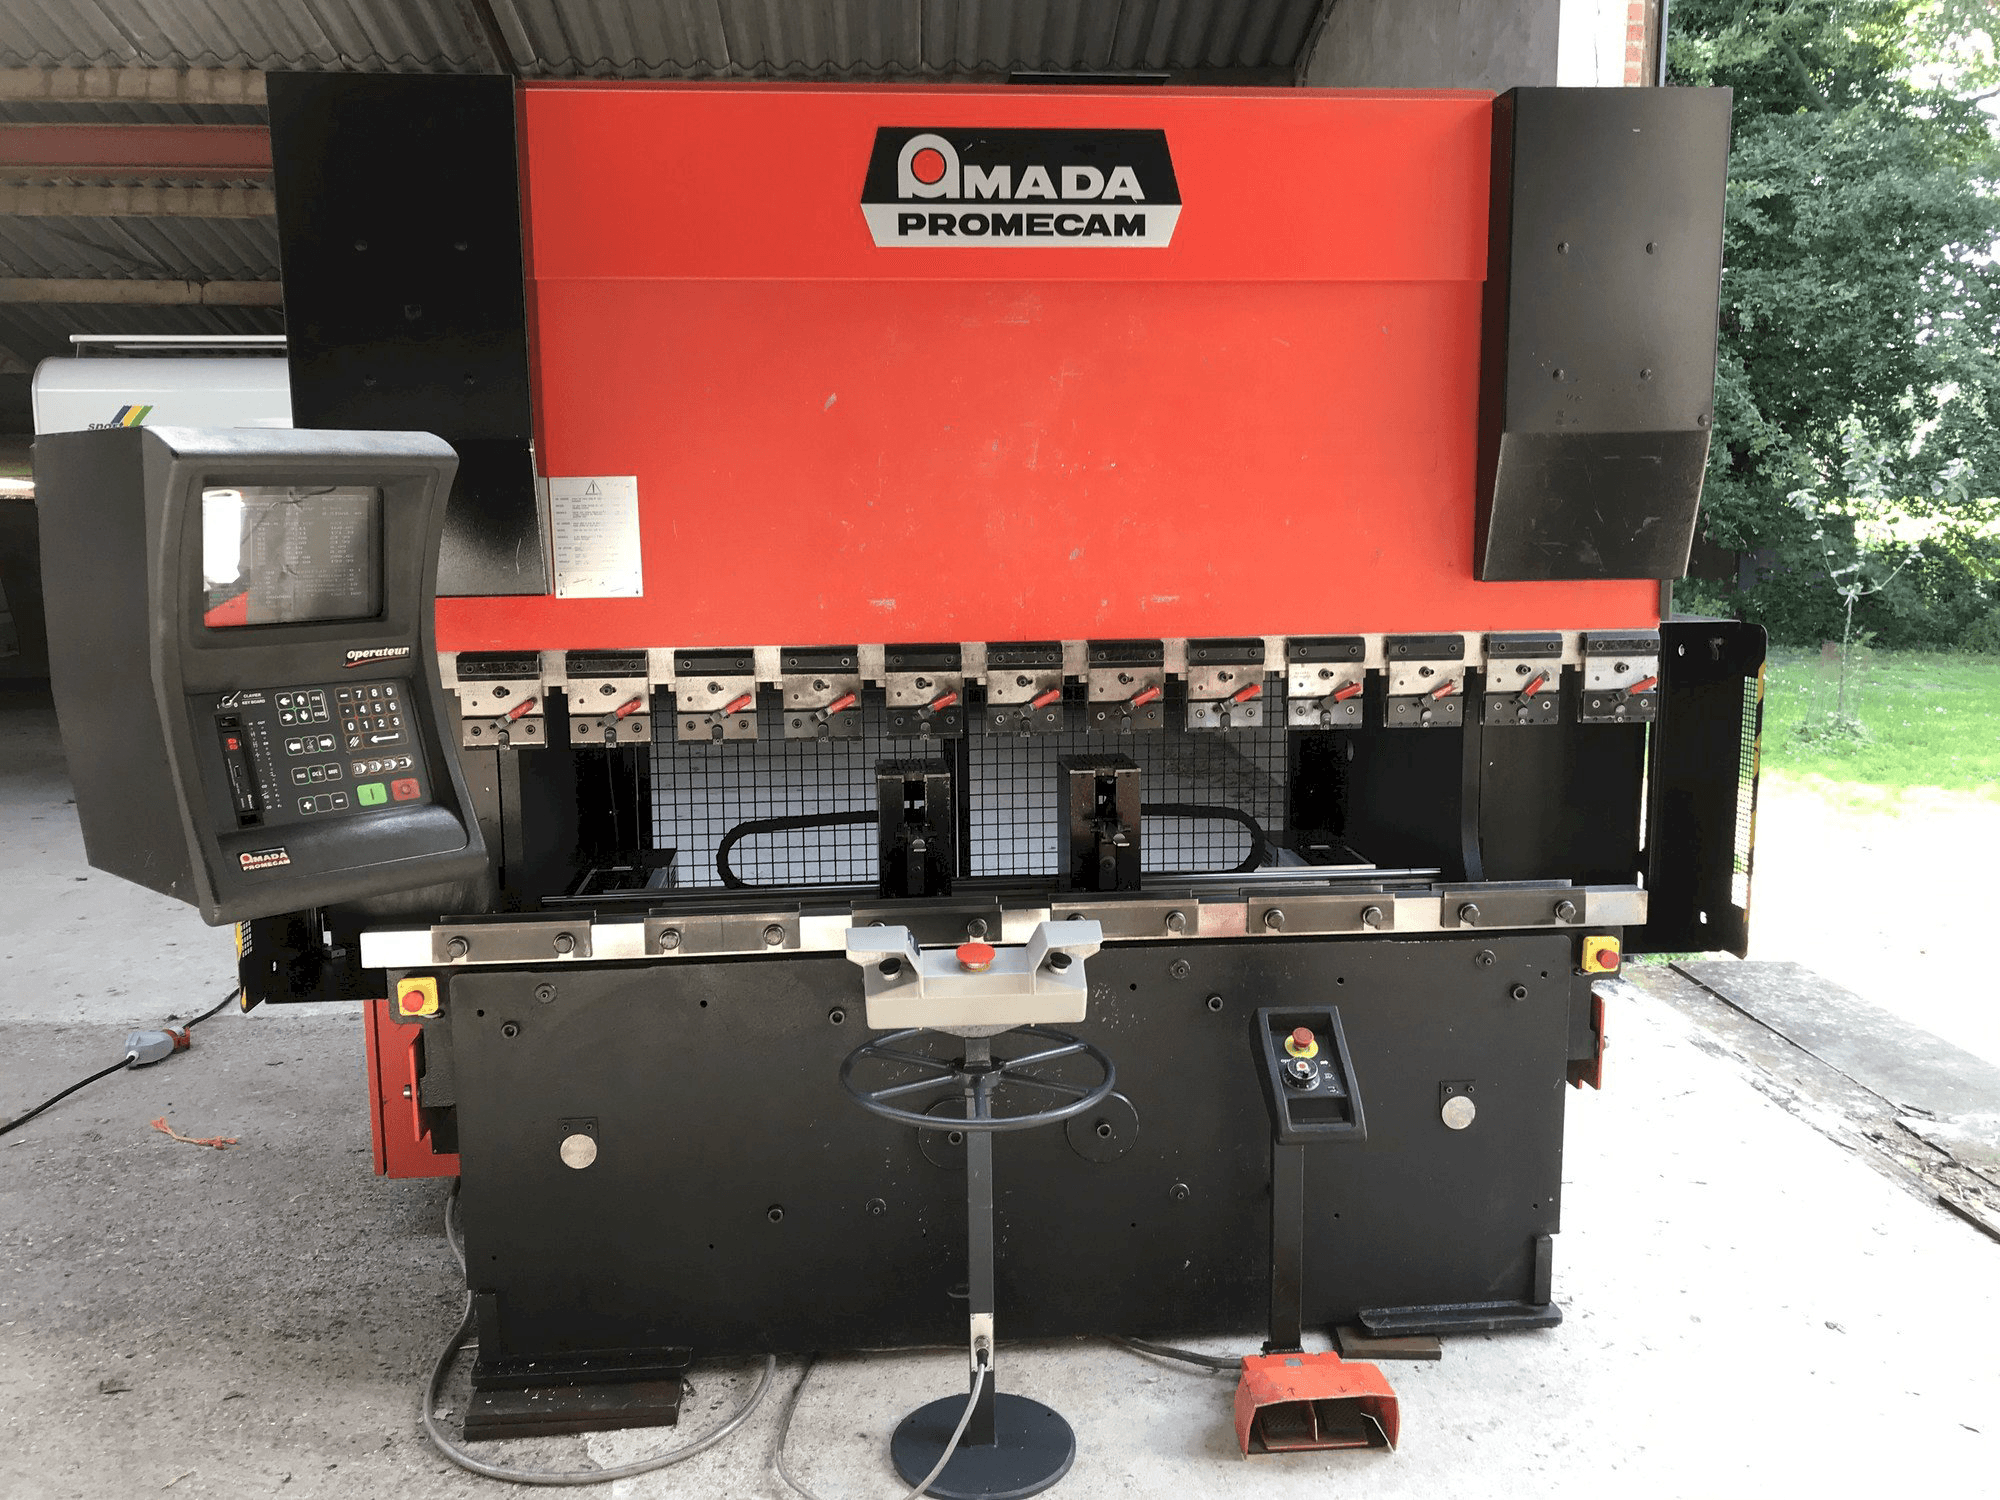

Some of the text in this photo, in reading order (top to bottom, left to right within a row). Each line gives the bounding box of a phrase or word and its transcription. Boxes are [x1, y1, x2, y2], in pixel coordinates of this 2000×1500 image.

[897, 133, 1146, 200] AMADA
[898, 213, 1146, 236] PROMECAM
[346, 647, 409, 660] operateur
[355, 687, 393, 698] 7 8 9
[360, 702, 396, 713] 4 5 6
[347, 717, 400, 731] 0 1 2 3
[239, 852, 288, 865] AMADA
[243, 859, 290, 870] PROMECAM
